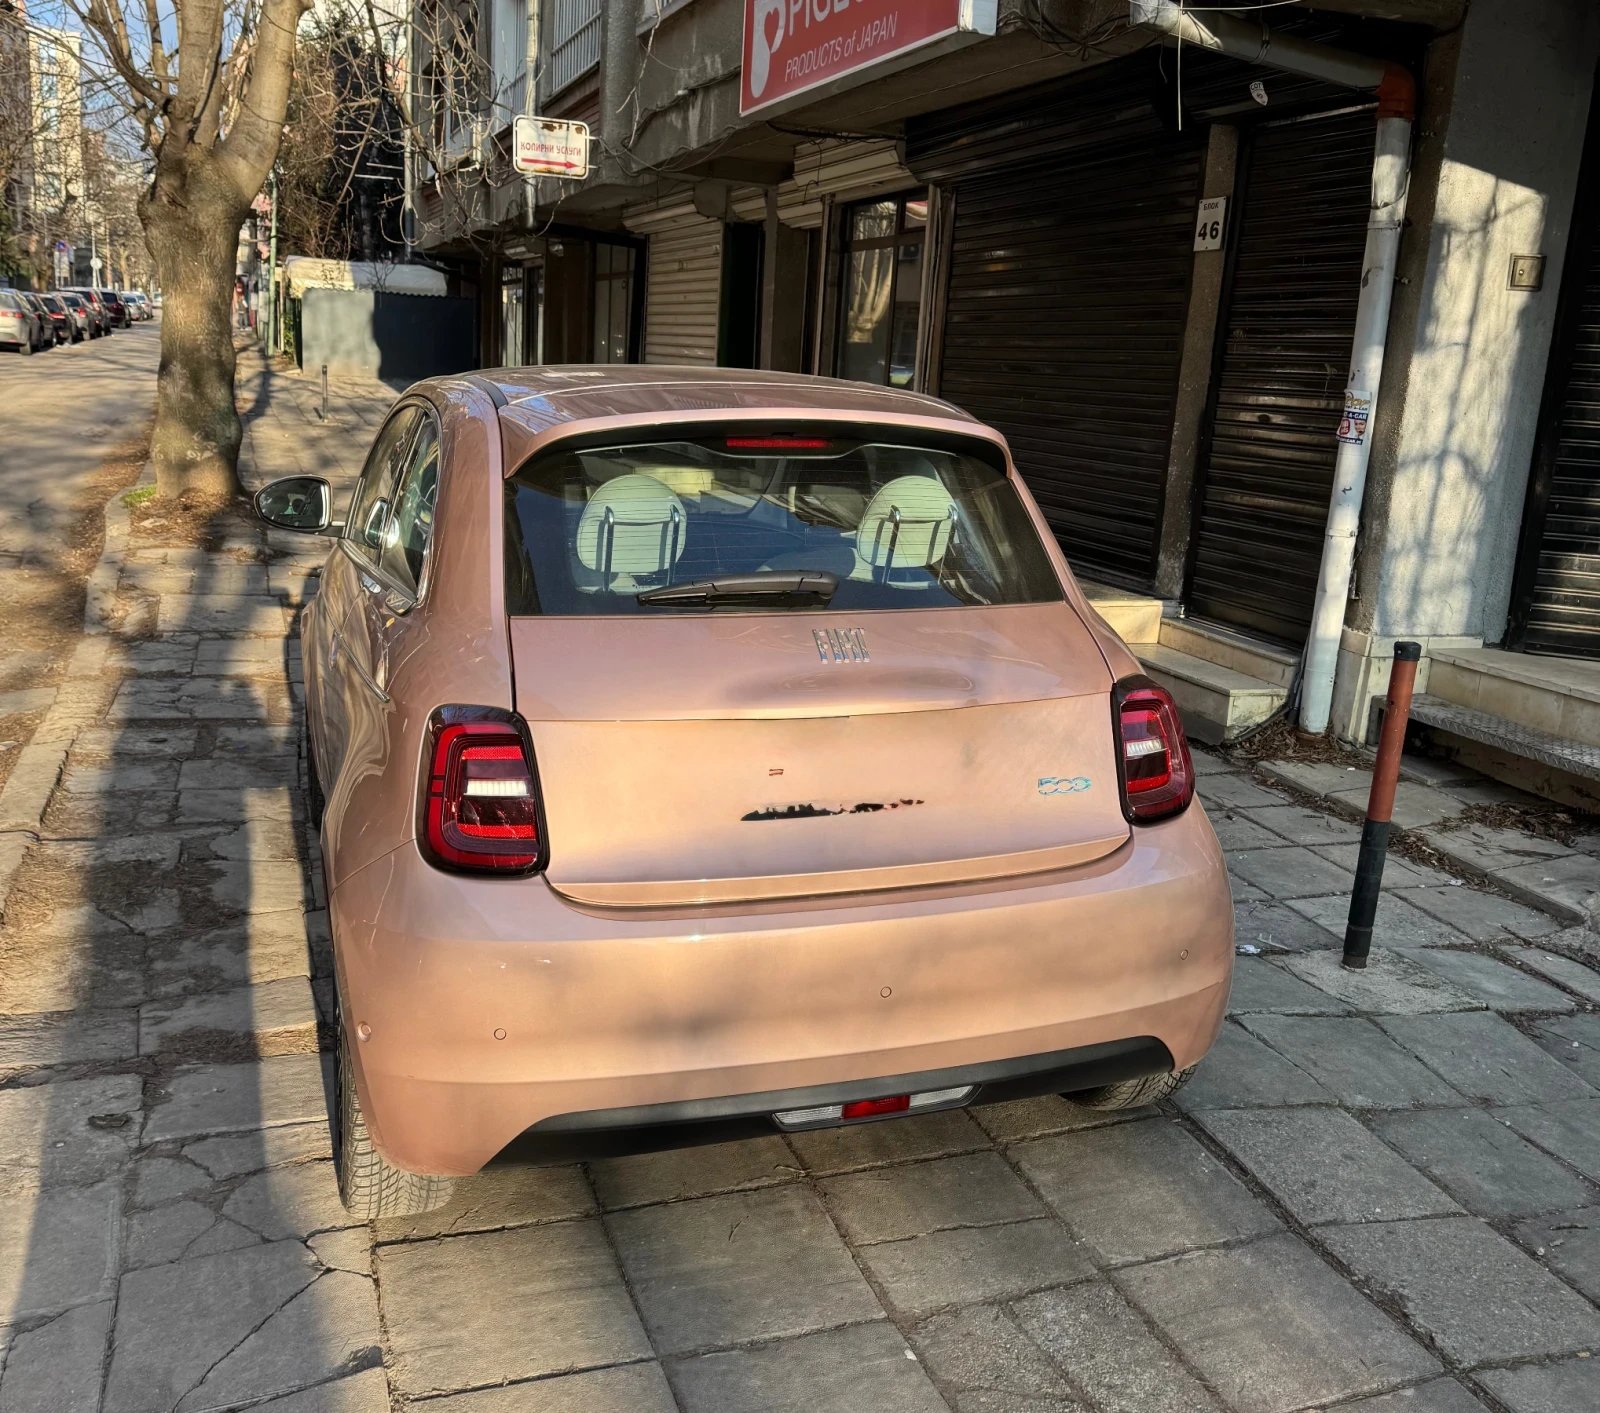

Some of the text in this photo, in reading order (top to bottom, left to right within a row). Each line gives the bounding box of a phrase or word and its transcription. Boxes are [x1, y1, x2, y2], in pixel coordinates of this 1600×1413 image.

[785, 11, 898, 82] PRODUCTS of JAPAN
[520, 142, 582, 156] КОПИРНИ УСЛУГИ
[1203, 202, 1220, 211] БЛОК
[1198, 220, 1220, 241] 46
[812, 628, 870, 664] FIAT
[1038, 776, 1092, 796] 500
